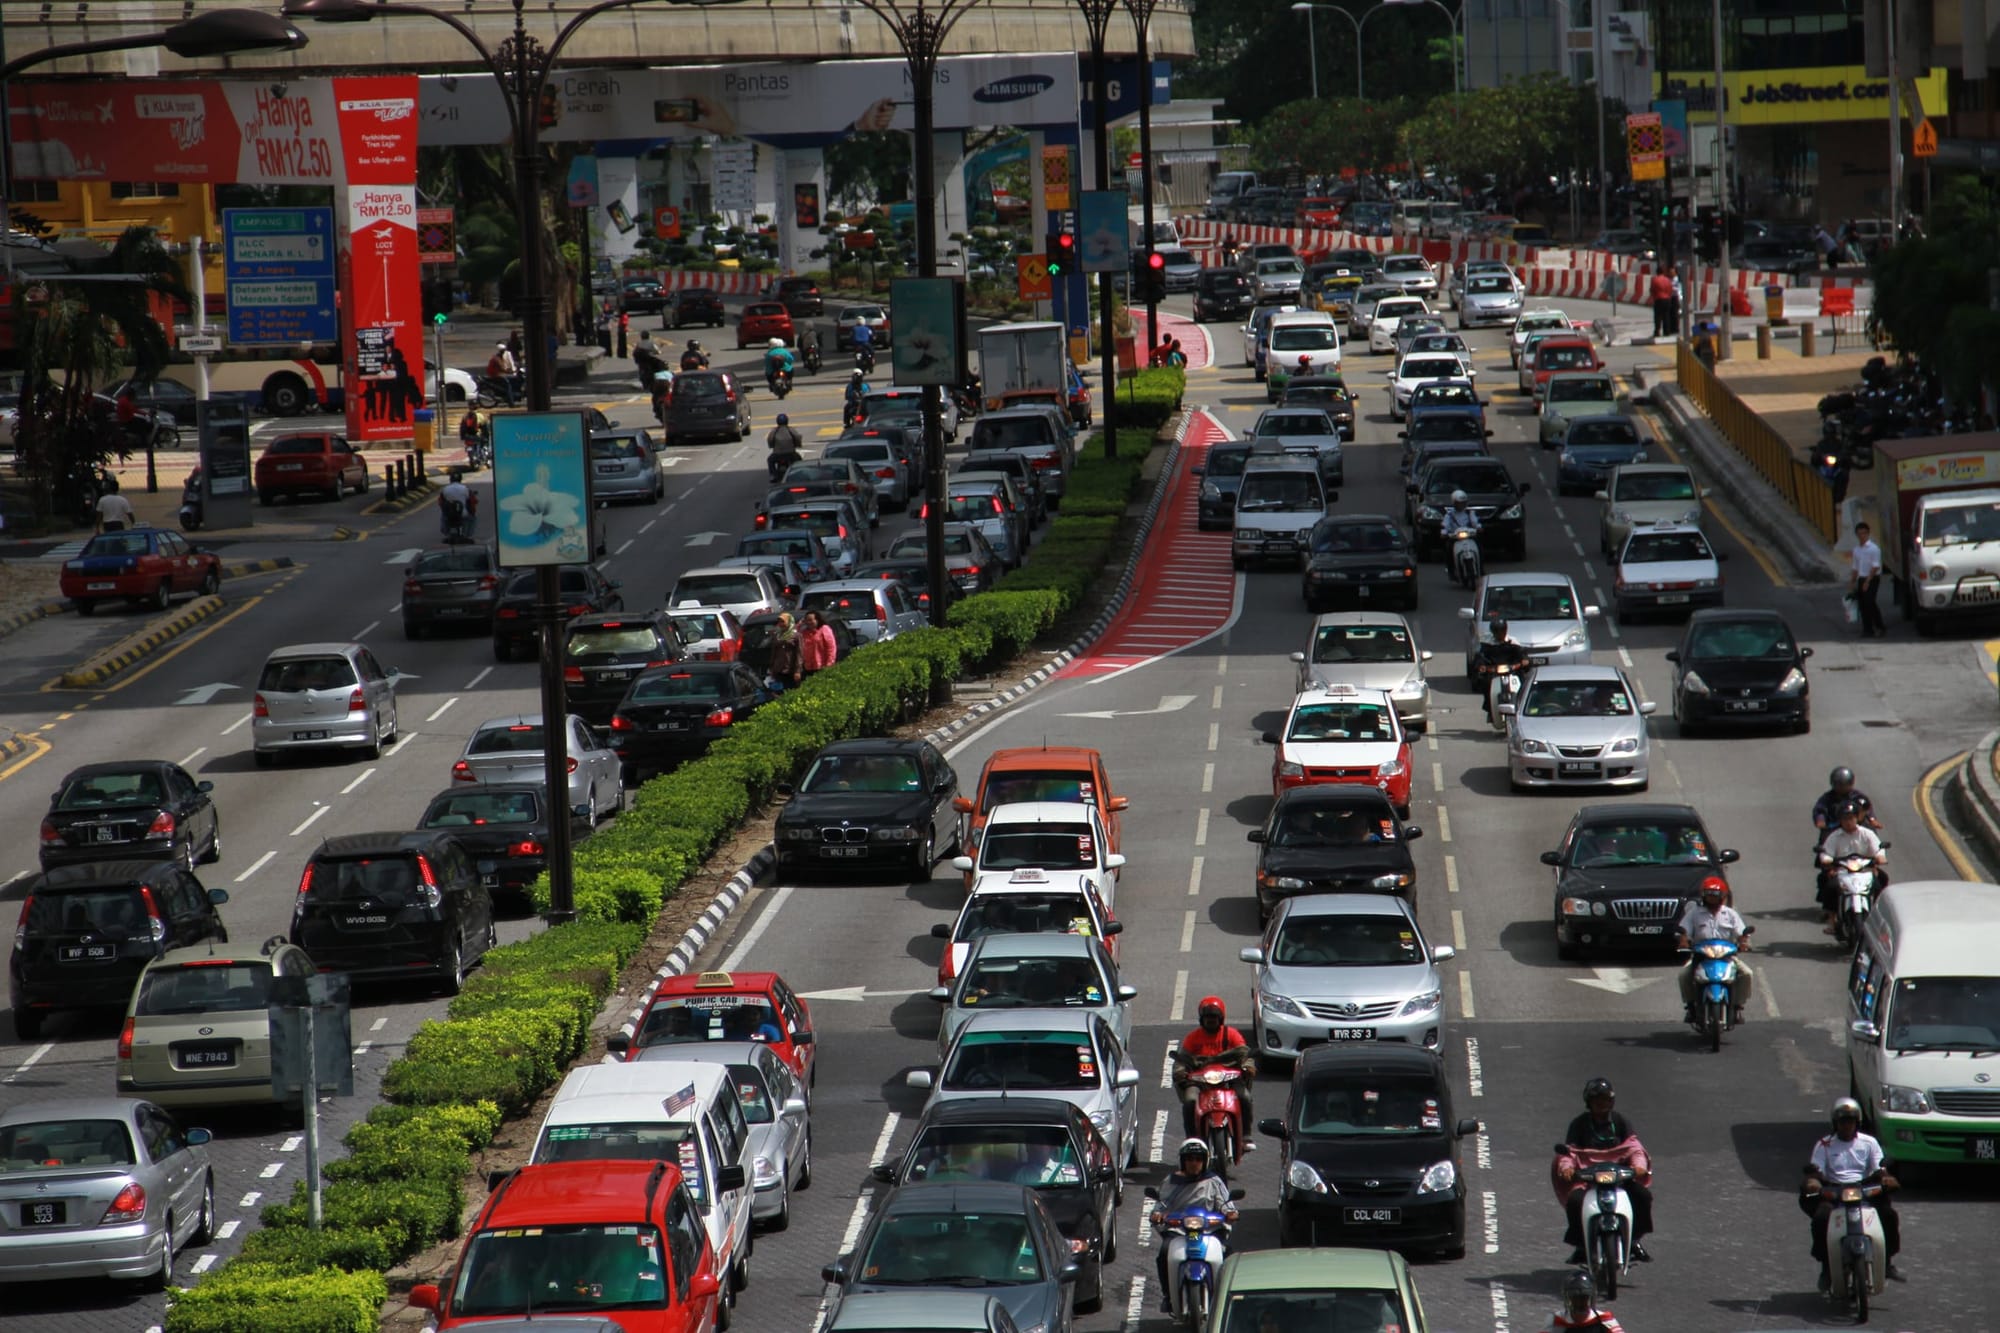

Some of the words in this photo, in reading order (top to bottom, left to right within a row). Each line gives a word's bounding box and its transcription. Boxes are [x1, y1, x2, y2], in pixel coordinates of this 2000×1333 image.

[564, 77, 621, 97] Cerah
[725, 73, 789, 91] Pantas
[983, 79, 1044, 97] SAMSUNG
[153, 100, 174, 113] KLIA
[255, 88, 313, 136] Hanya
[256, 138, 333, 178] RM12.50
[364, 192, 402, 206] Hanya
[360, 204, 411, 217] RM12.50
[240, 217, 283, 226] AMPANG
[238, 239, 265, 248] KLCC
[238, 250, 283, 258] MENARA
[234, 285, 272, 294] Dataran
[274, 284, 314, 293] Merdeka
[685, 996, 716, 1004] PUBLIC
[720, 996, 738, 1004] CAB
[1351, 1029, 1372, 1039] 353
[185, 1053, 203, 1063] WNE
[206, 1051, 228, 1062] 7843
[33, 1203, 53, 1214] WPB
[34, 1214, 53, 1223] 323
[1353, 1209, 1371, 1221] CCL
[1373, 1209, 1392, 1221] 4211
